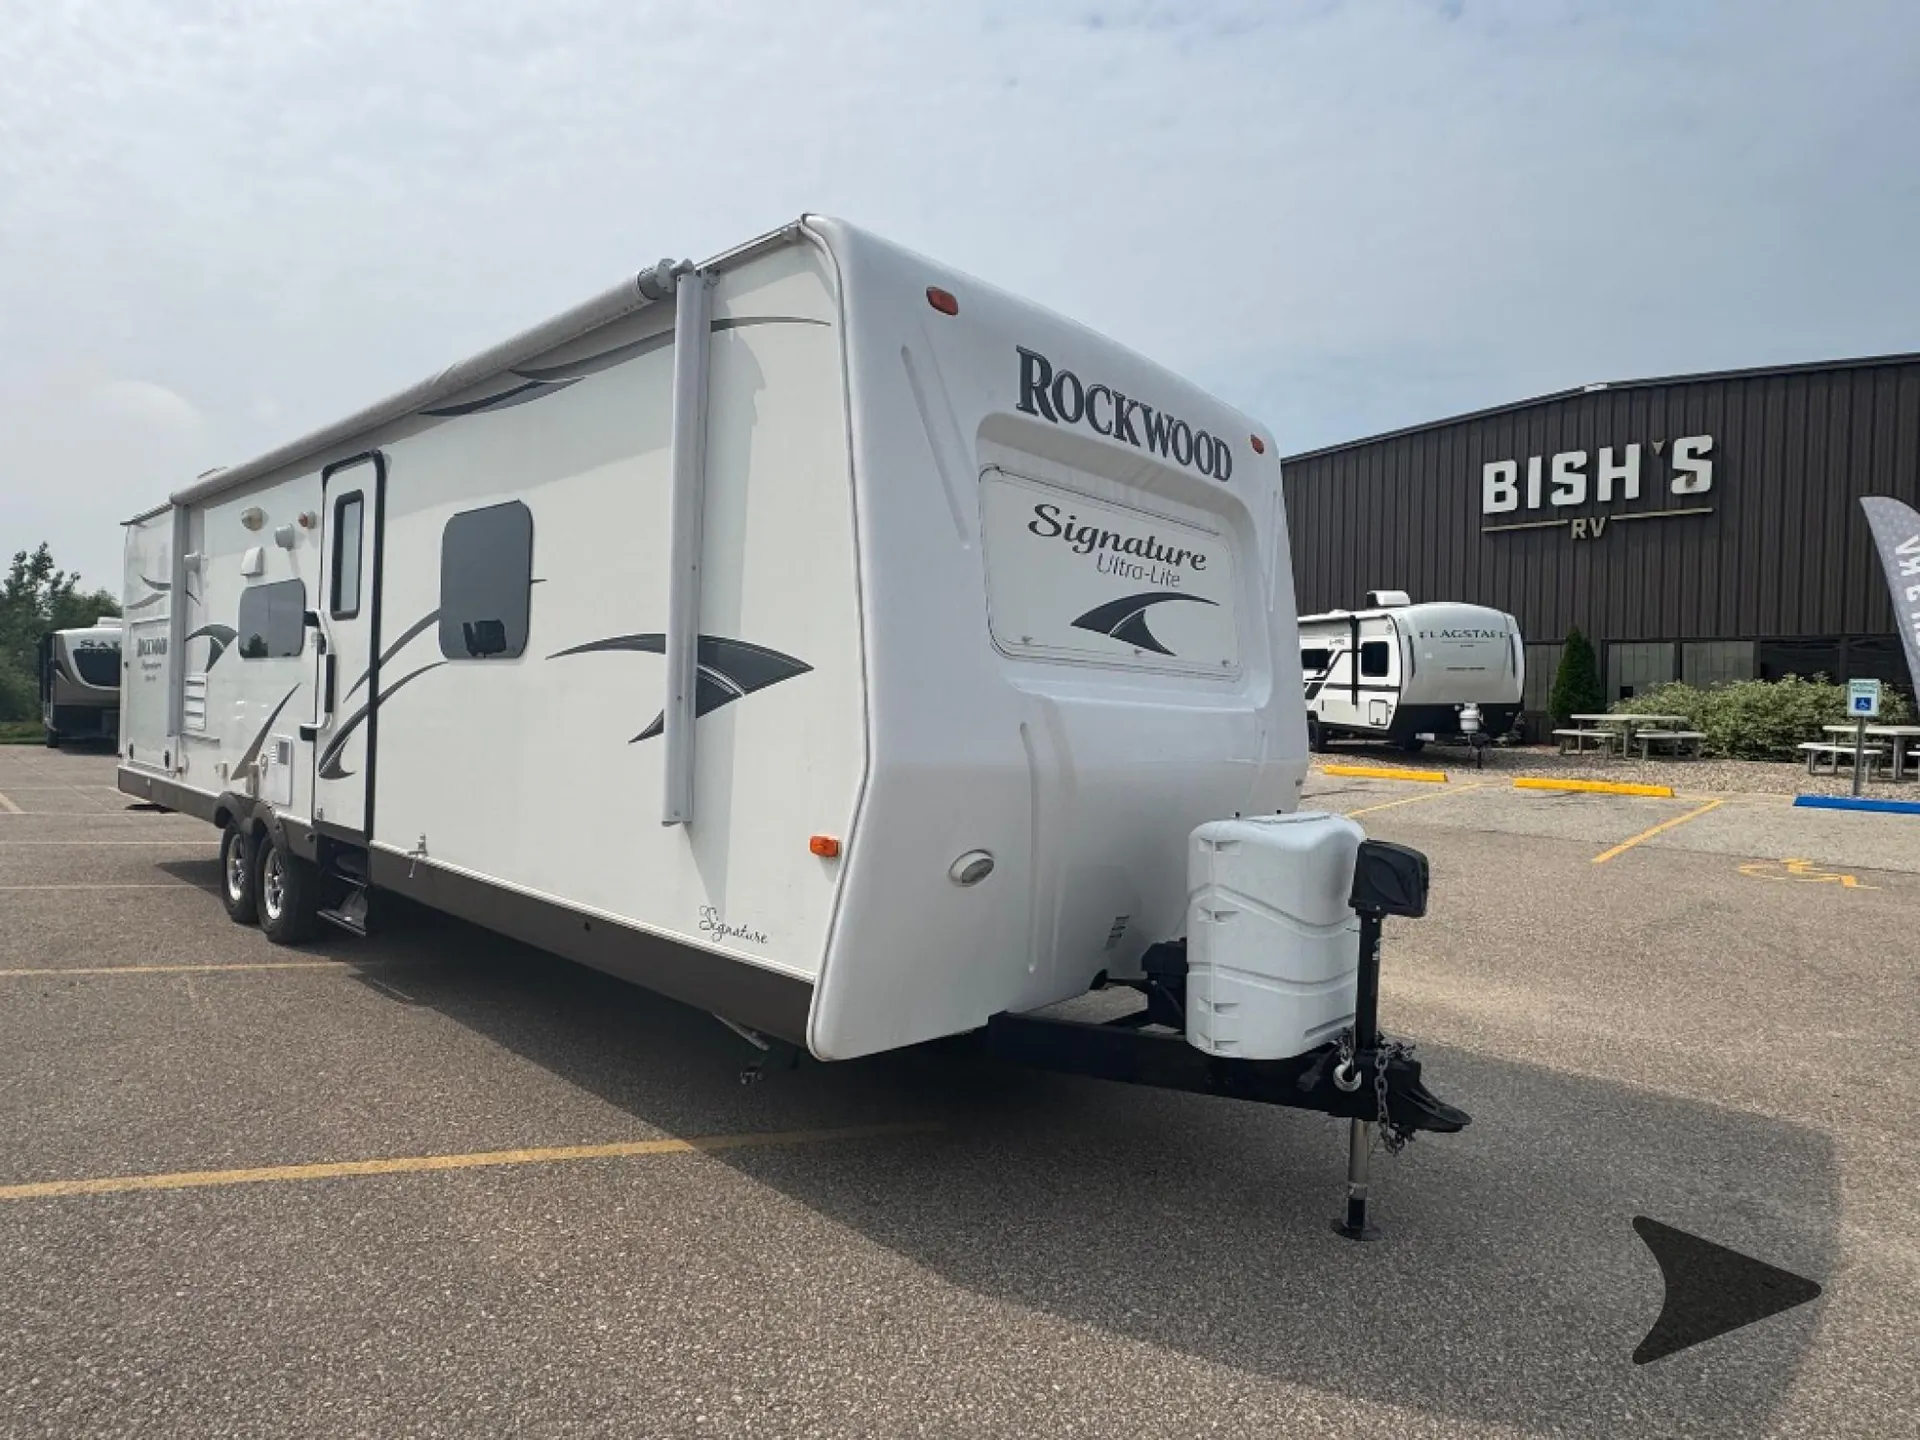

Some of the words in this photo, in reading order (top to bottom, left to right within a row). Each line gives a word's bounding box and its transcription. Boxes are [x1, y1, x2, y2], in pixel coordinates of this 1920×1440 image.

[1016, 344, 1233, 482] ROCKWOOD
[1483, 435, 1713, 515] BISH'S
[1028, 503, 1207, 571] Signature
[1570, 517, 1607, 540] RV
[1096, 552, 1181, 588] Ultra-Lite
[699, 905, 768, 943] Signature
